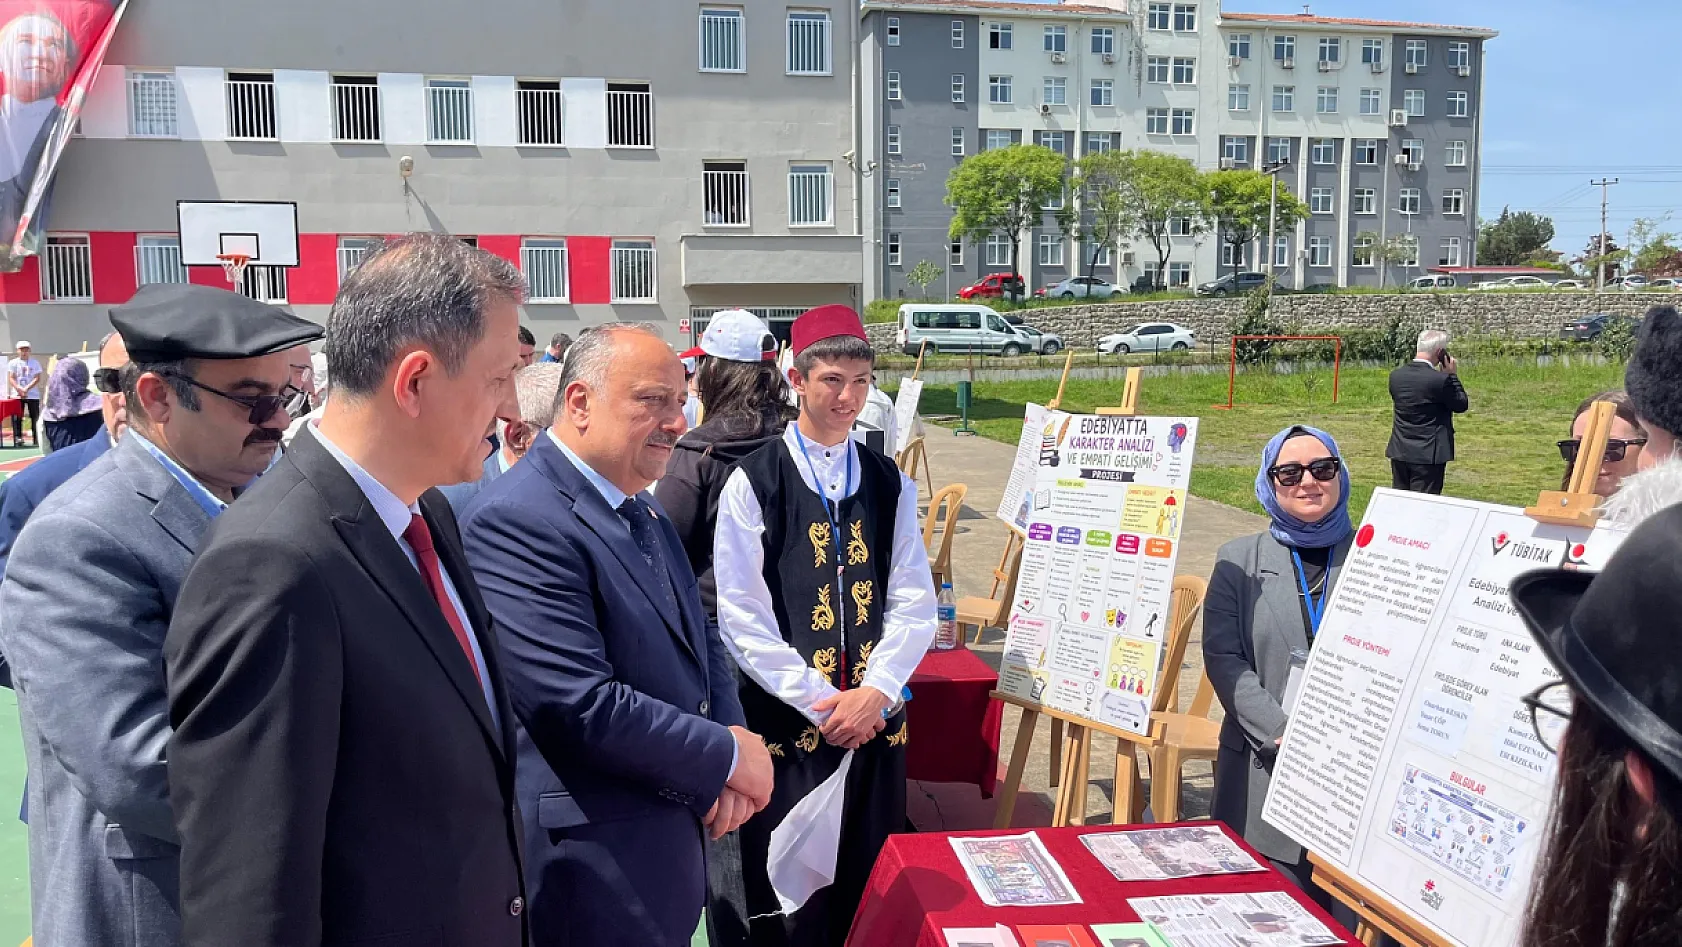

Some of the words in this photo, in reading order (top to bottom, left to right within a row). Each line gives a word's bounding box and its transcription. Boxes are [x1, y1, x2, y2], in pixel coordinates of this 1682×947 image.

[1080, 416, 1147, 436] EDEBİYATTA
[1068, 436, 1116, 451] KARAKTER
[1117, 435, 1155, 452] ANALİZİ
[1067, 452, 1078, 465] VE
[1080, 452, 1111, 466] EMPATİ
[1114, 452, 1153, 469] GELİŞİMİ
[1091, 469, 1124, 481] PROJESİ
[1511, 541, 1552, 563] TÜBİTAK
[1472, 596, 1506, 613] Analizi
[1451, 638, 1480, 653] İnceleme
[1499, 653, 1510, 664] Dil
[1490, 662, 1520, 678] Edebiyat
[1450, 771, 1487, 796] BULGULAR
